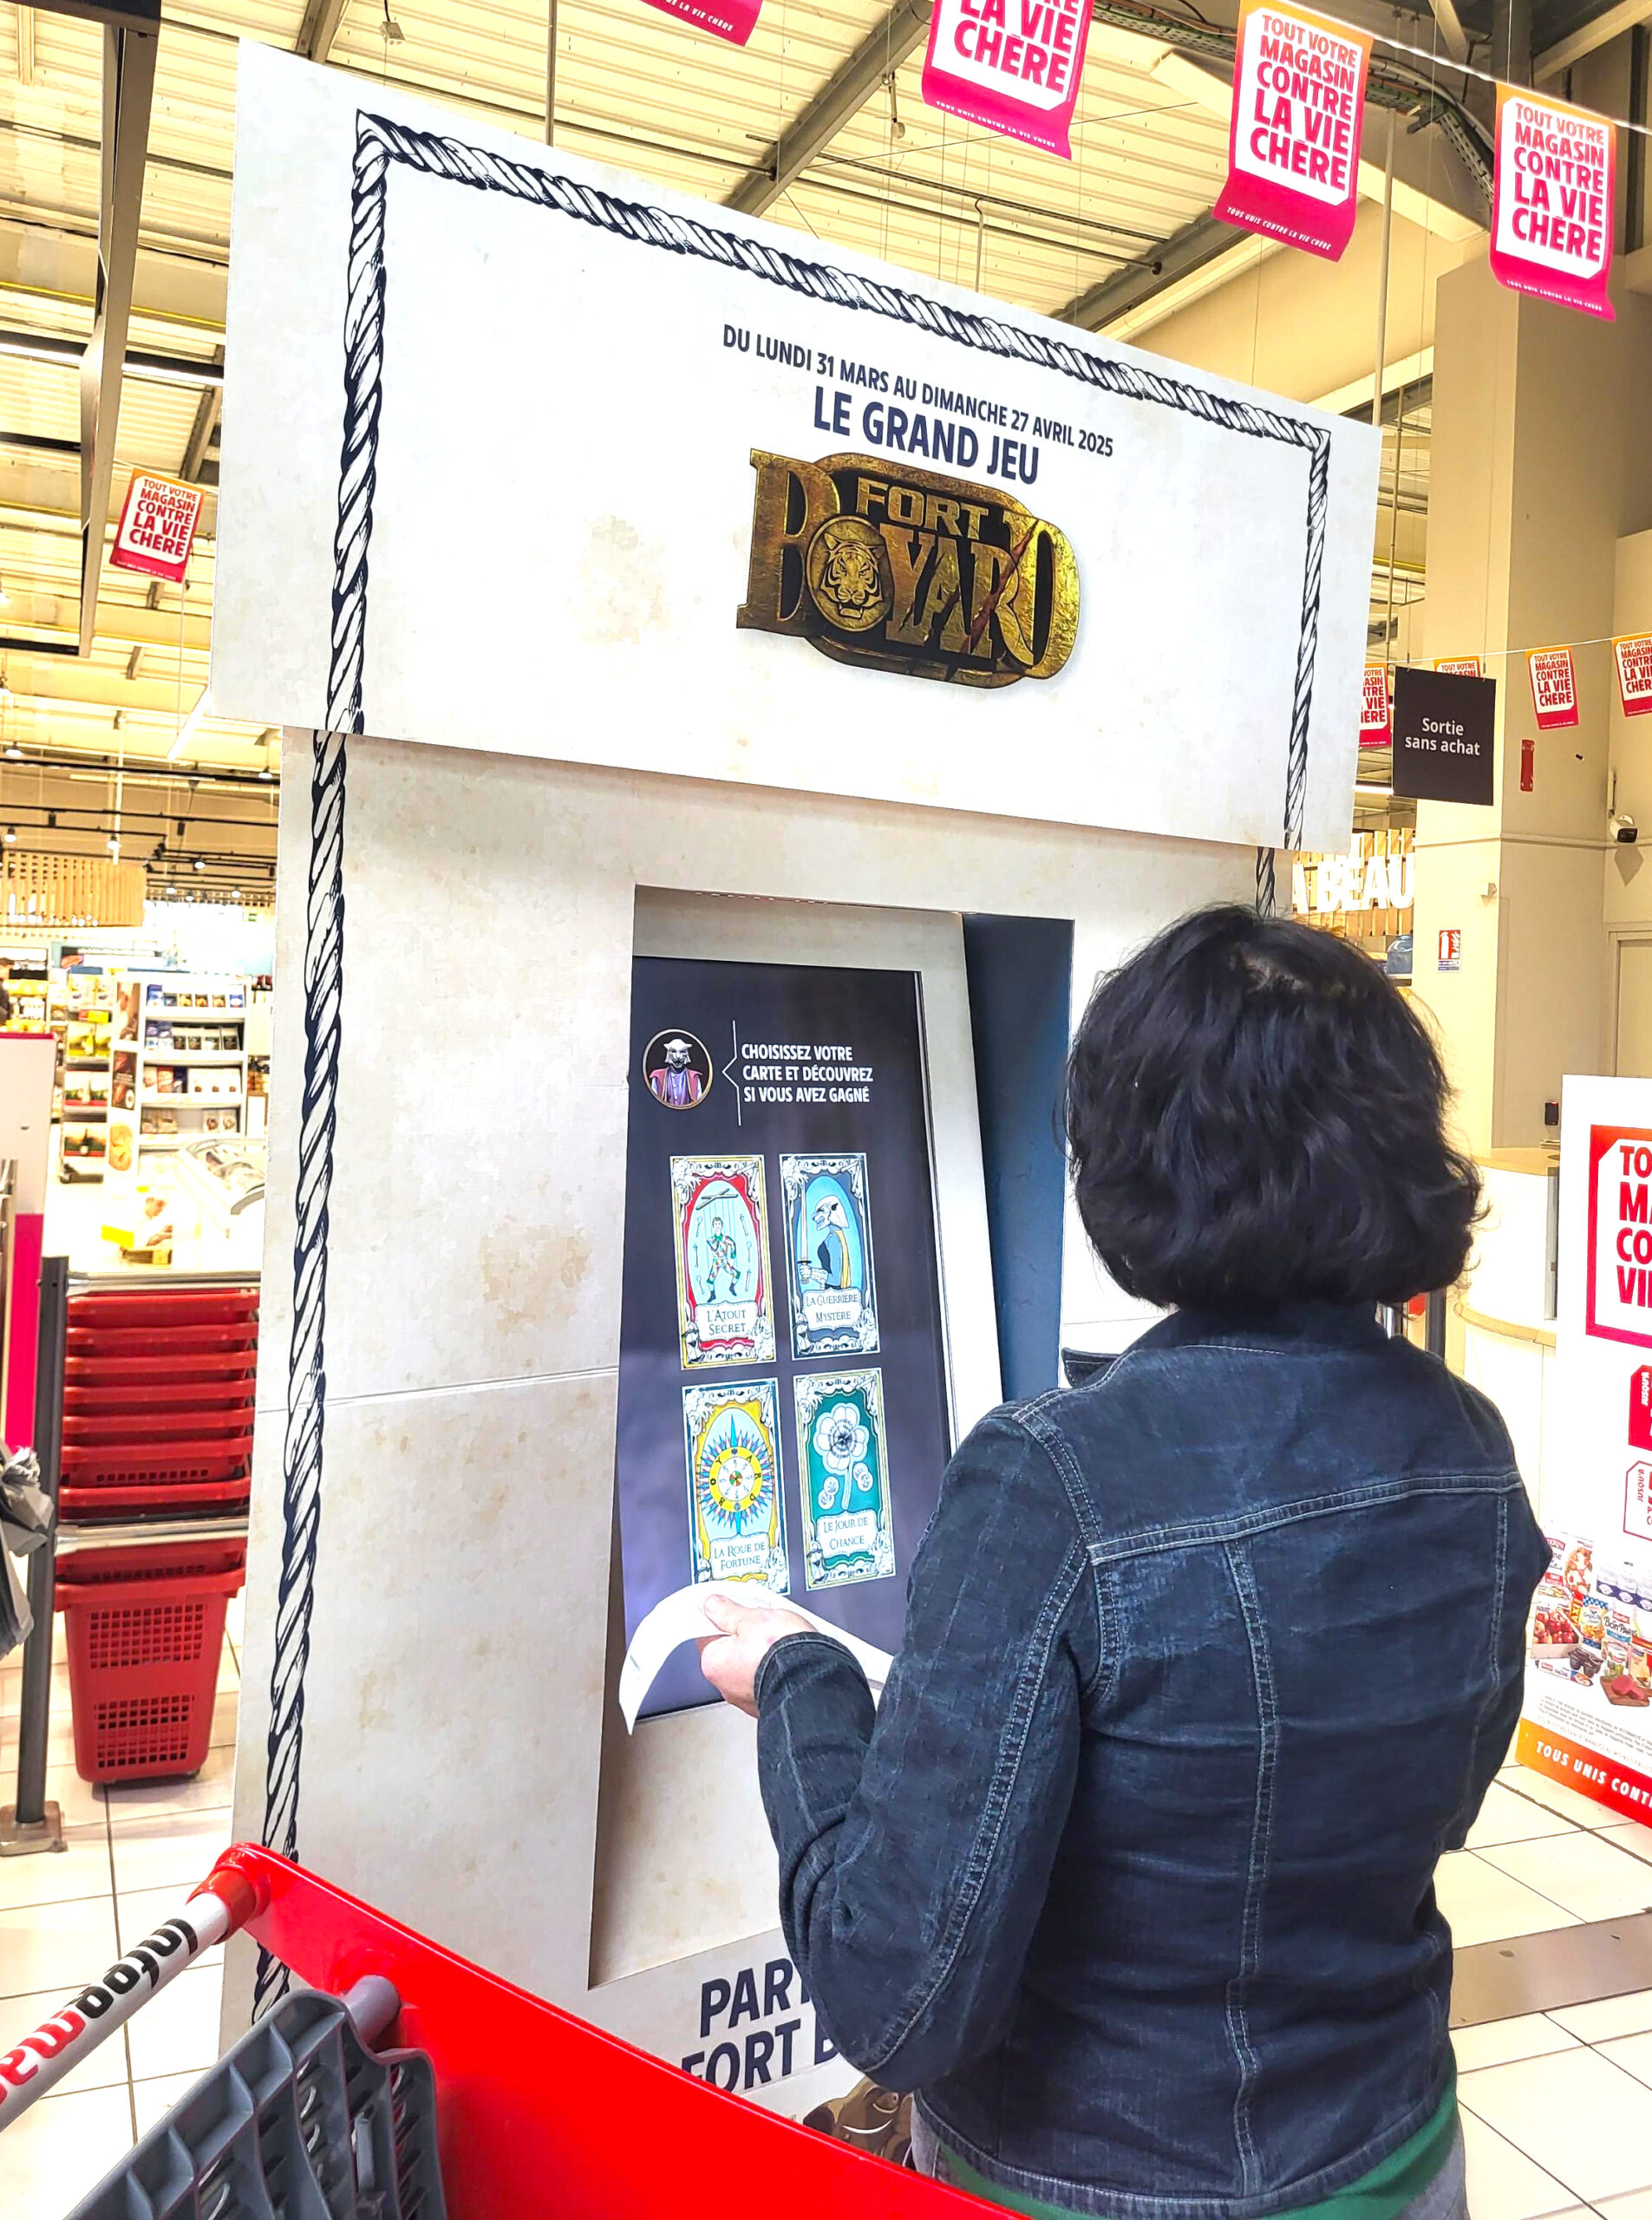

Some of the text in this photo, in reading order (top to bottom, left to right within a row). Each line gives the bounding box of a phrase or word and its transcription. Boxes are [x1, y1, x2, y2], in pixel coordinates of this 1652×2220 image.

[679, 1, 690, 12] LA
[692, 7, 707, 19] VIE
[1021, 0, 1076, 54] VIE
[1262, 14, 1358, 69] TOUT VOTRE
[1259, 35, 1355, 94] MAGASIN
[1257, 61, 1354, 122] CONTRE
[1254, 88, 1350, 156] LA VIE
[1515, 102, 1604, 147] TOUT VOTRE
[1514, 121, 1604, 169] MAGASIN
[1513, 147, 1604, 196] CONTRE
[1514, 172, 1603, 229] LA VIE
[1226, 206, 1244, 219] TOUS
[1244, 213, 1262, 225] UNIS
[1263, 220, 1289, 235] CONTRE
[723, 323, 1113, 458] DU LUNDI 31 MARS AU DIMANCHE 27 AVRIL 2025
[814, 385, 1039, 486] LE GRAND JEU
[140, 488, 195, 513] MAGASIN
[144, 479, 198, 502] TOUT VOTRE
[137, 500, 193, 526] CONTRE
[856, 476, 989, 539] FORT
[133, 512, 190, 541] LA VIE
[1457, 662, 1476, 670] VOTRE
[1534, 651, 1567, 663] TOUT VOTRE
[1535, 659, 1568, 671] MAGASIN
[1536, 669, 1570, 681] CONTRE
[1623, 668, 1637, 681] LA
[1538, 678, 1570, 694] LA VIE
[1366, 696, 1385, 709] VIE
[1421, 717, 1464, 736] Sortie
[1405, 736, 1480, 756] sans achat
[1316, 852, 1415, 912] BEAU
[741, 1043, 853, 1061] CHOISISSEZ VOTRE
[742, 1064, 874, 1082] CARTE ET DÉCOUVREZ
[743, 1086, 871, 1103] SI VOUS AVEZ GAGNÉ
[806, 1295, 816, 1307] LA
[708, 1323, 746, 1335] SECRET
[824, 1517, 869, 1534] LE JOUR DE
[714, 1542, 766, 1560] LA ROUE DE
[829, 1535, 865, 1551] CHANCE
[721, 1555, 761, 1571] FORTUNE
[1536, 1740, 1570, 1766] TOUS
[1573, 1759, 1607, 1785] UNIS
